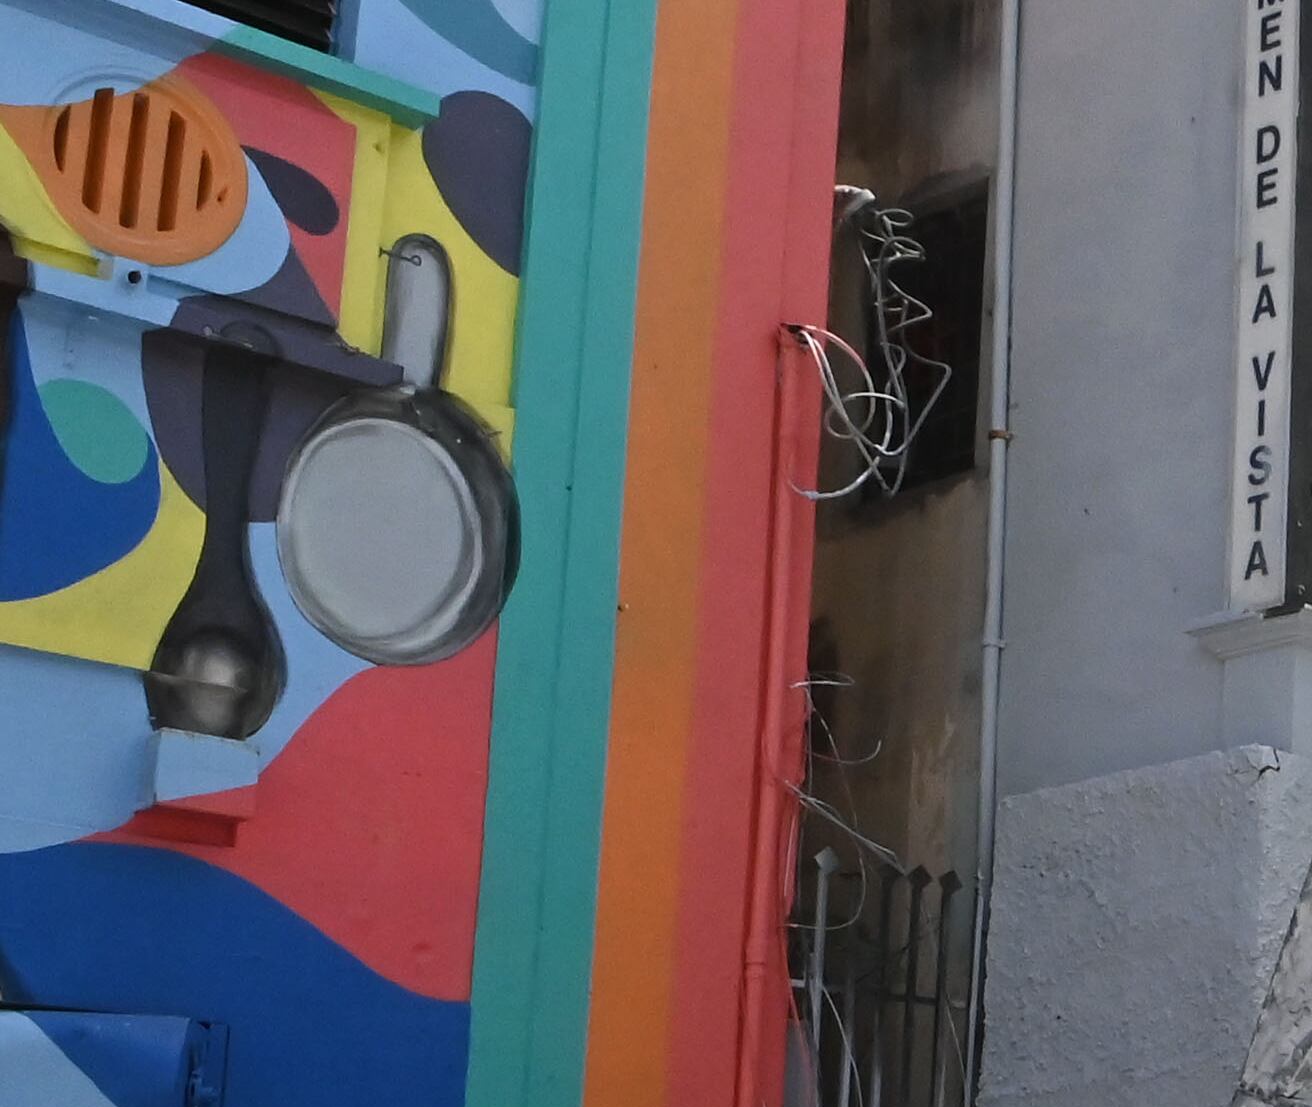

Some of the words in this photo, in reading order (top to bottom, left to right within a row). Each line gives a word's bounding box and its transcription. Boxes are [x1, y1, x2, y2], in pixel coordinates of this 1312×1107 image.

[1256, 0, 1284, 97] EN
[1256, 125, 1281, 209] DE
[1252, 241, 1276, 325] LA
[1244, 351, 1276, 580] VISTA
